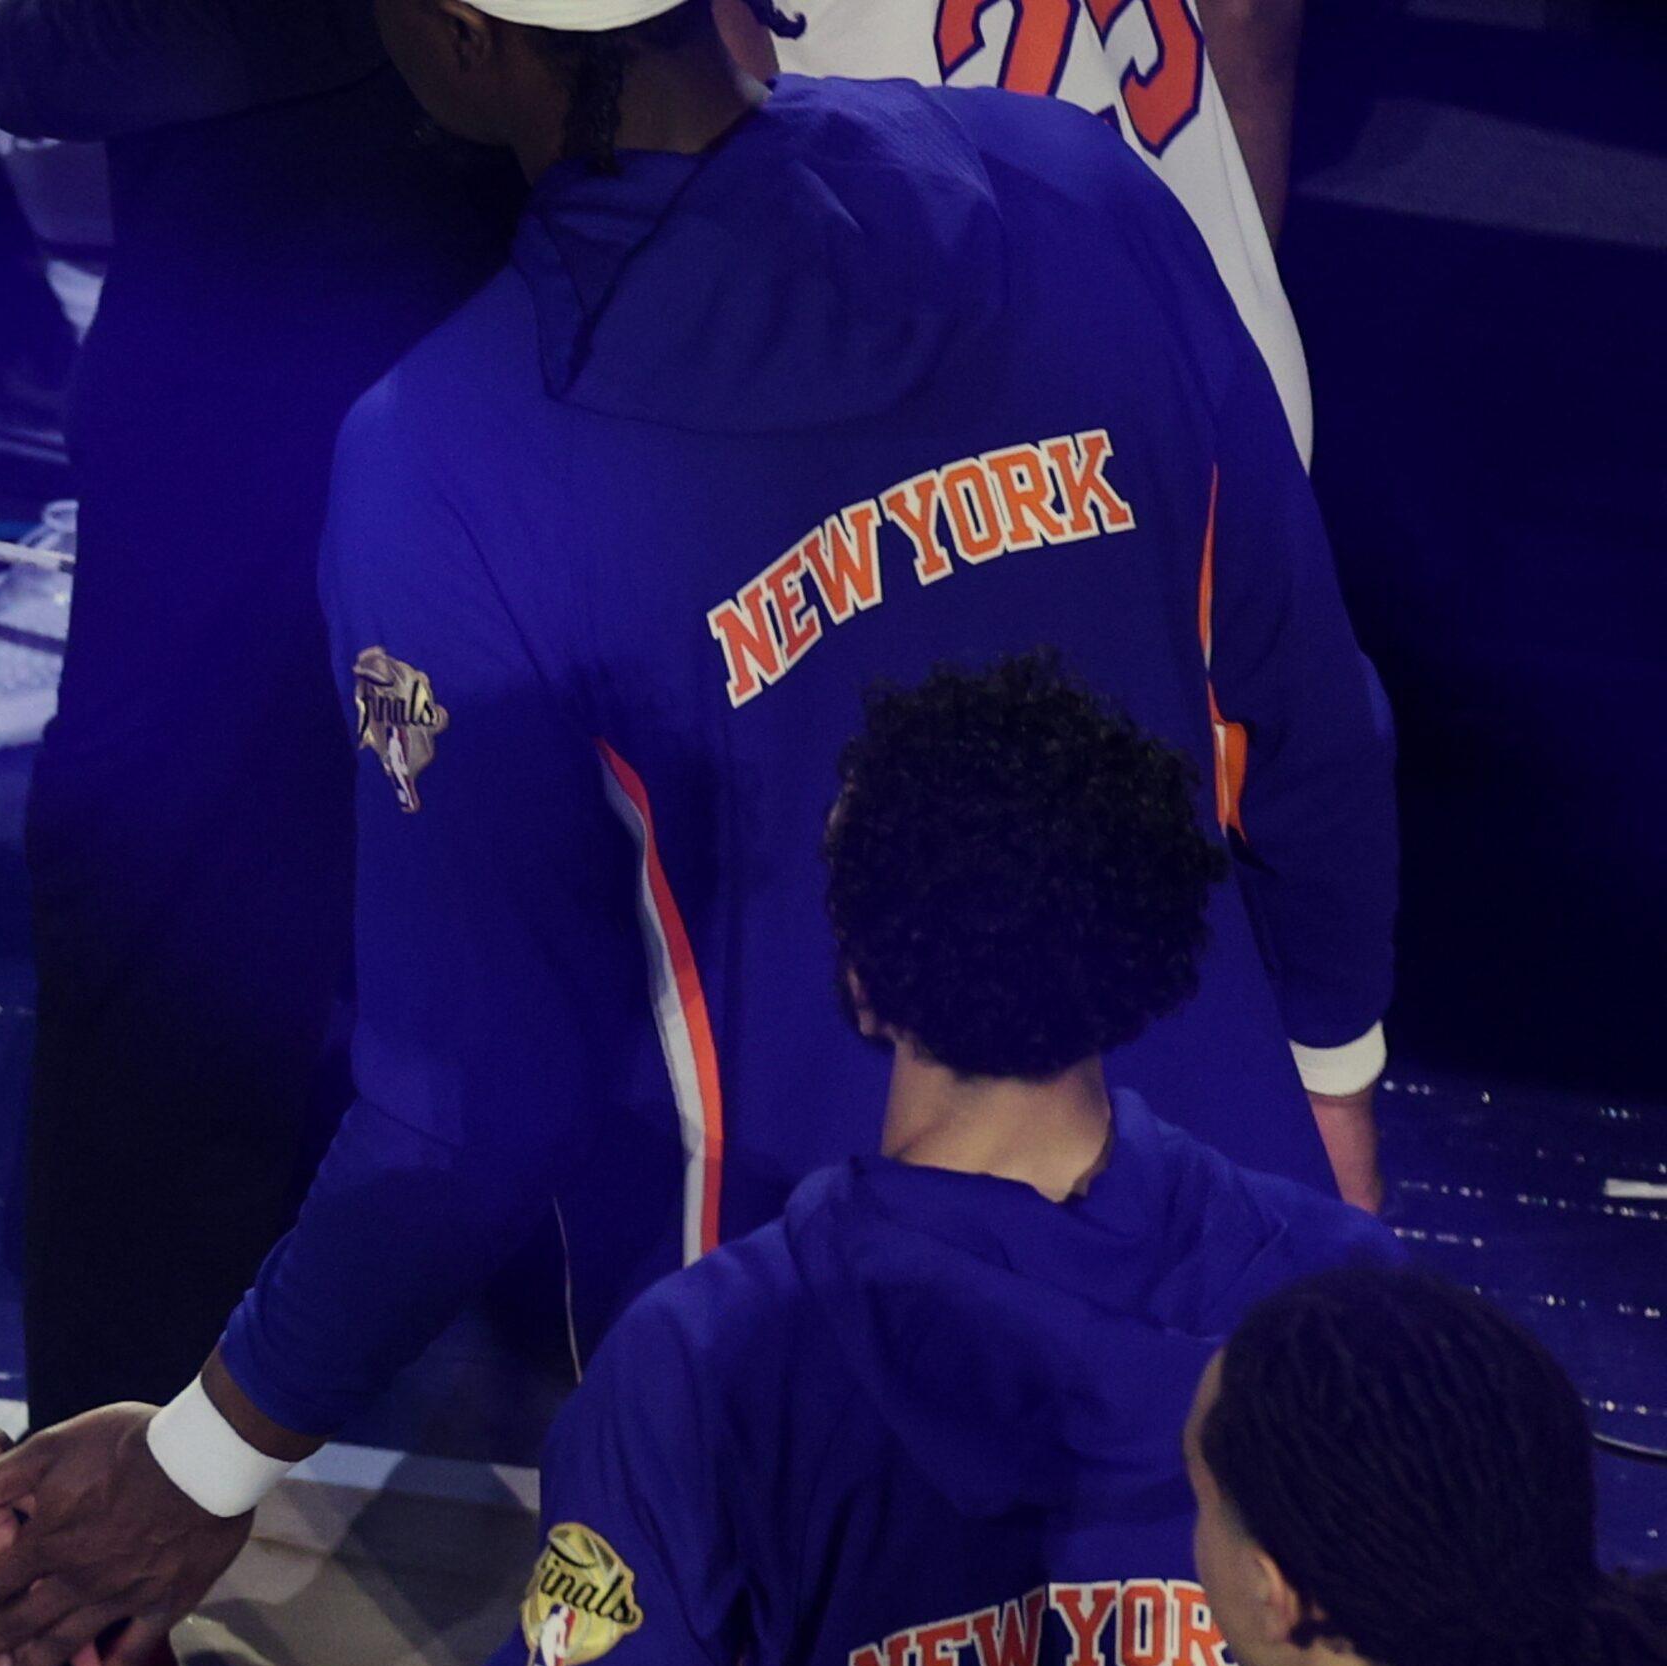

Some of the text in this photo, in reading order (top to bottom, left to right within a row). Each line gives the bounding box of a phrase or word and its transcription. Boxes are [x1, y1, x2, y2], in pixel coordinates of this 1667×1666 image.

[707, 428, 1135, 709] NEW YORK
[539, 1557, 637, 1624] inals
